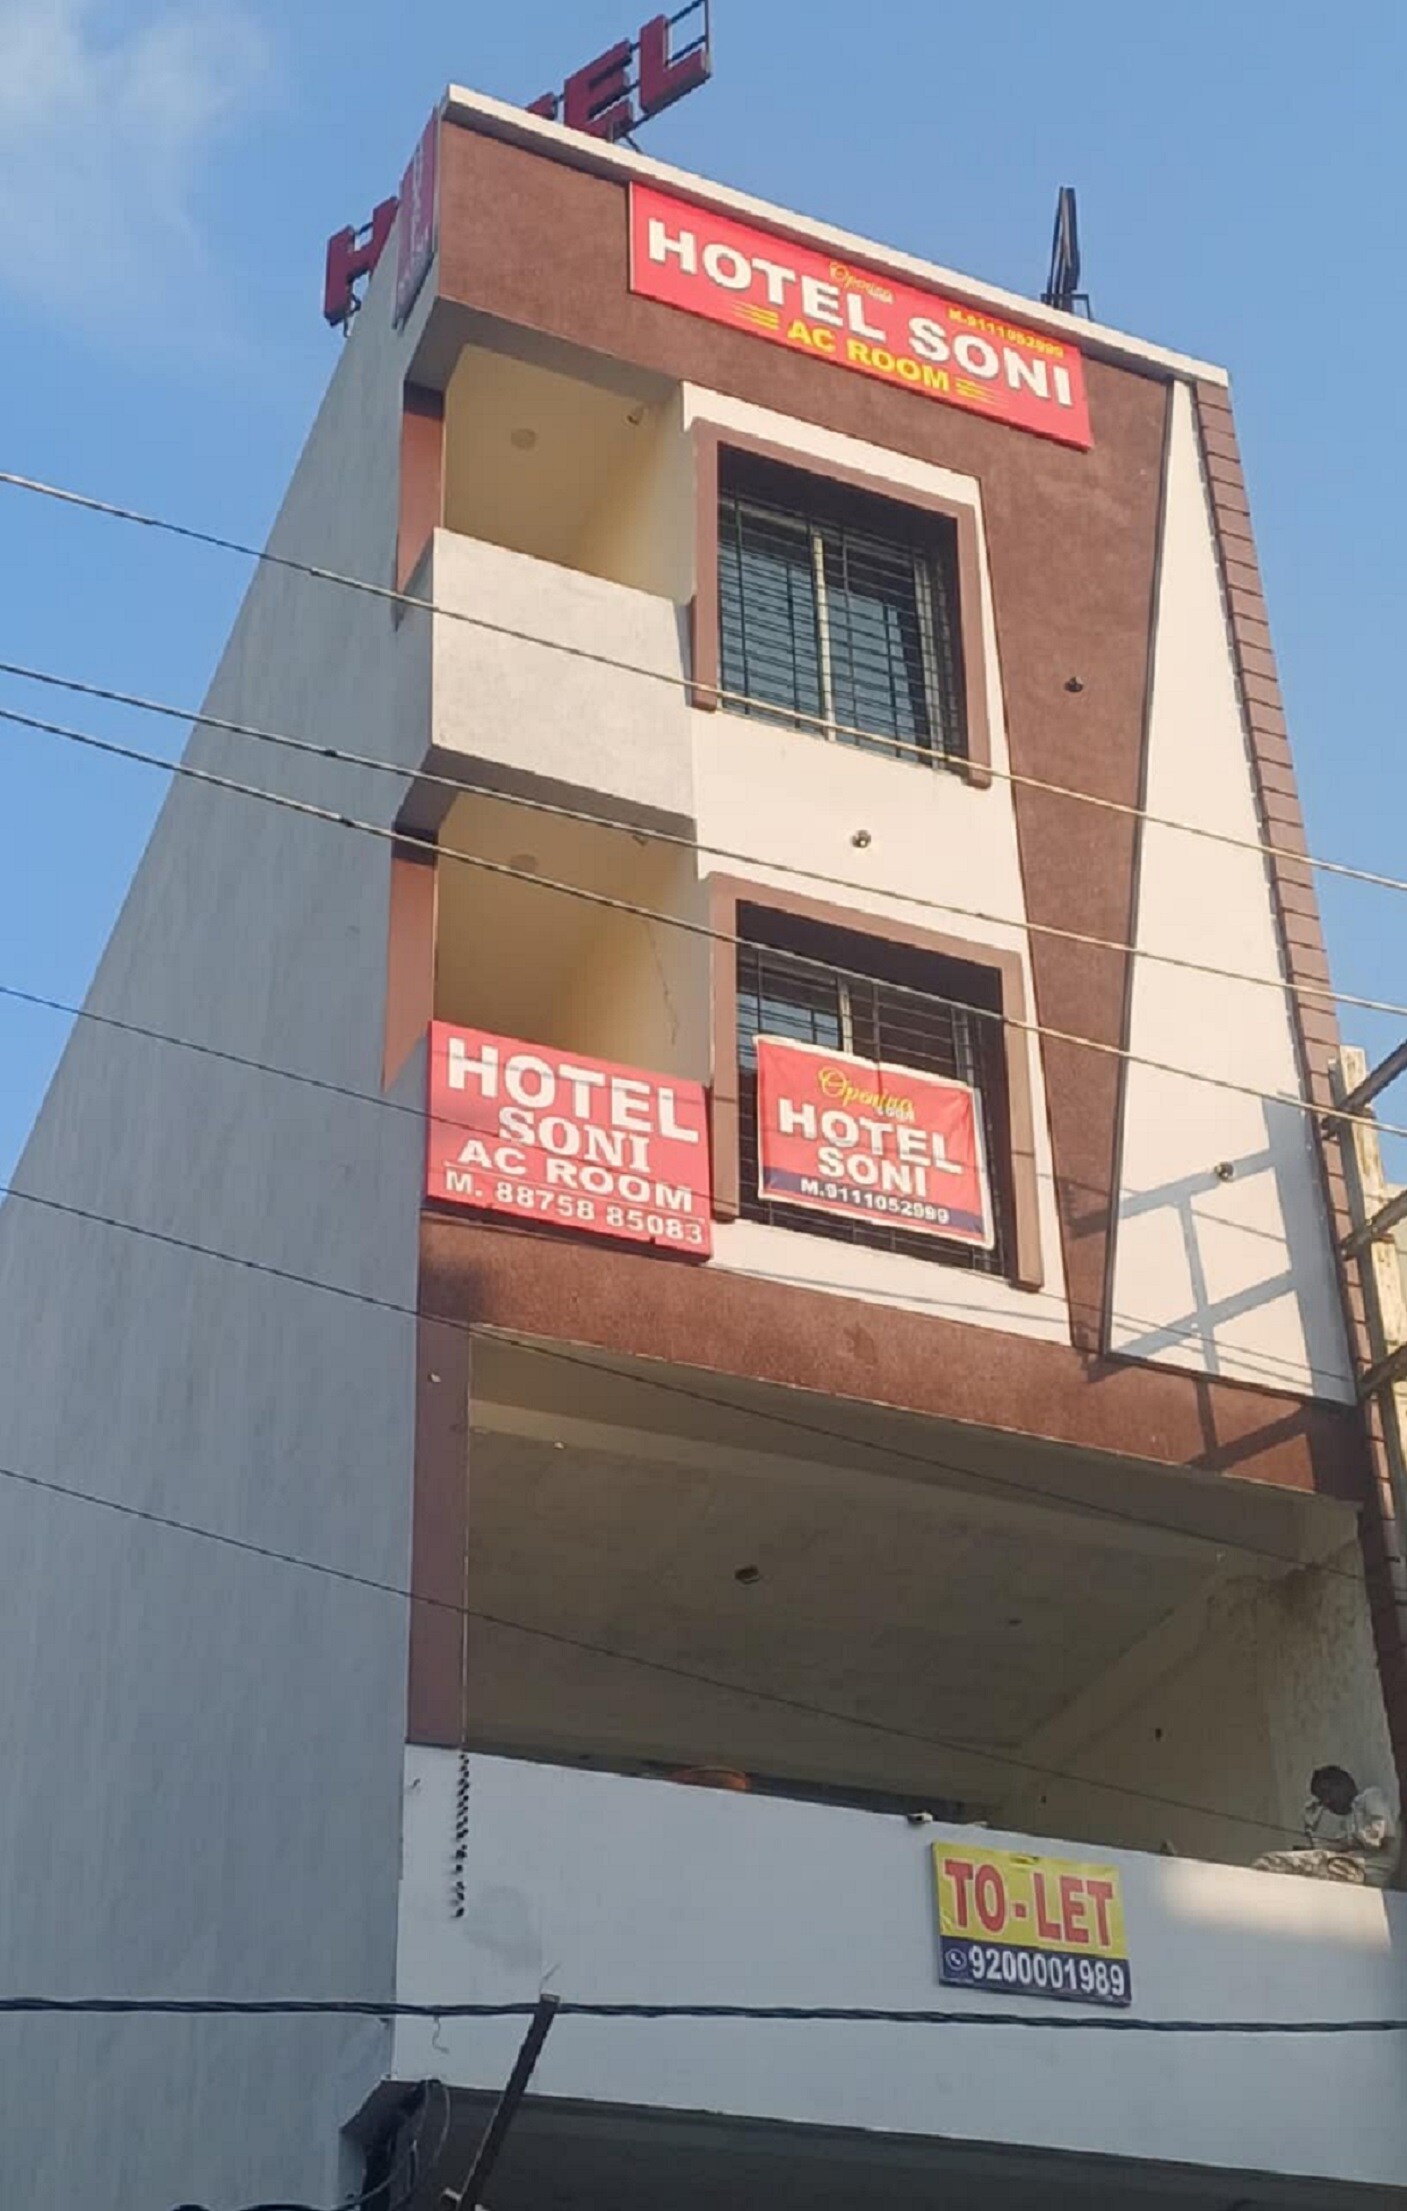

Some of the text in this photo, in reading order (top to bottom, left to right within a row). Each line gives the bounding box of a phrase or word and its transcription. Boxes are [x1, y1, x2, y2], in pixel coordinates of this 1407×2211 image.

[648, 217, 1073, 406] HOTEL SONI
[788, 320, 950, 392] AC ROOM
[447, 1037, 699, 1144] HOTEL
[818, 1066, 913, 1112] Opening
[499, 1106, 650, 1174] SONI
[778, 1098, 963, 1174] HOTEL
[817, 1146, 927, 1197] SONI
[445, 1169, 703, 1244] M. 88758 85083
[457, 1139, 693, 1212] AC ROOM
[800, 1177, 950, 1225] M.9111052999
[969, 1946, 1125, 1996] 9200001989
